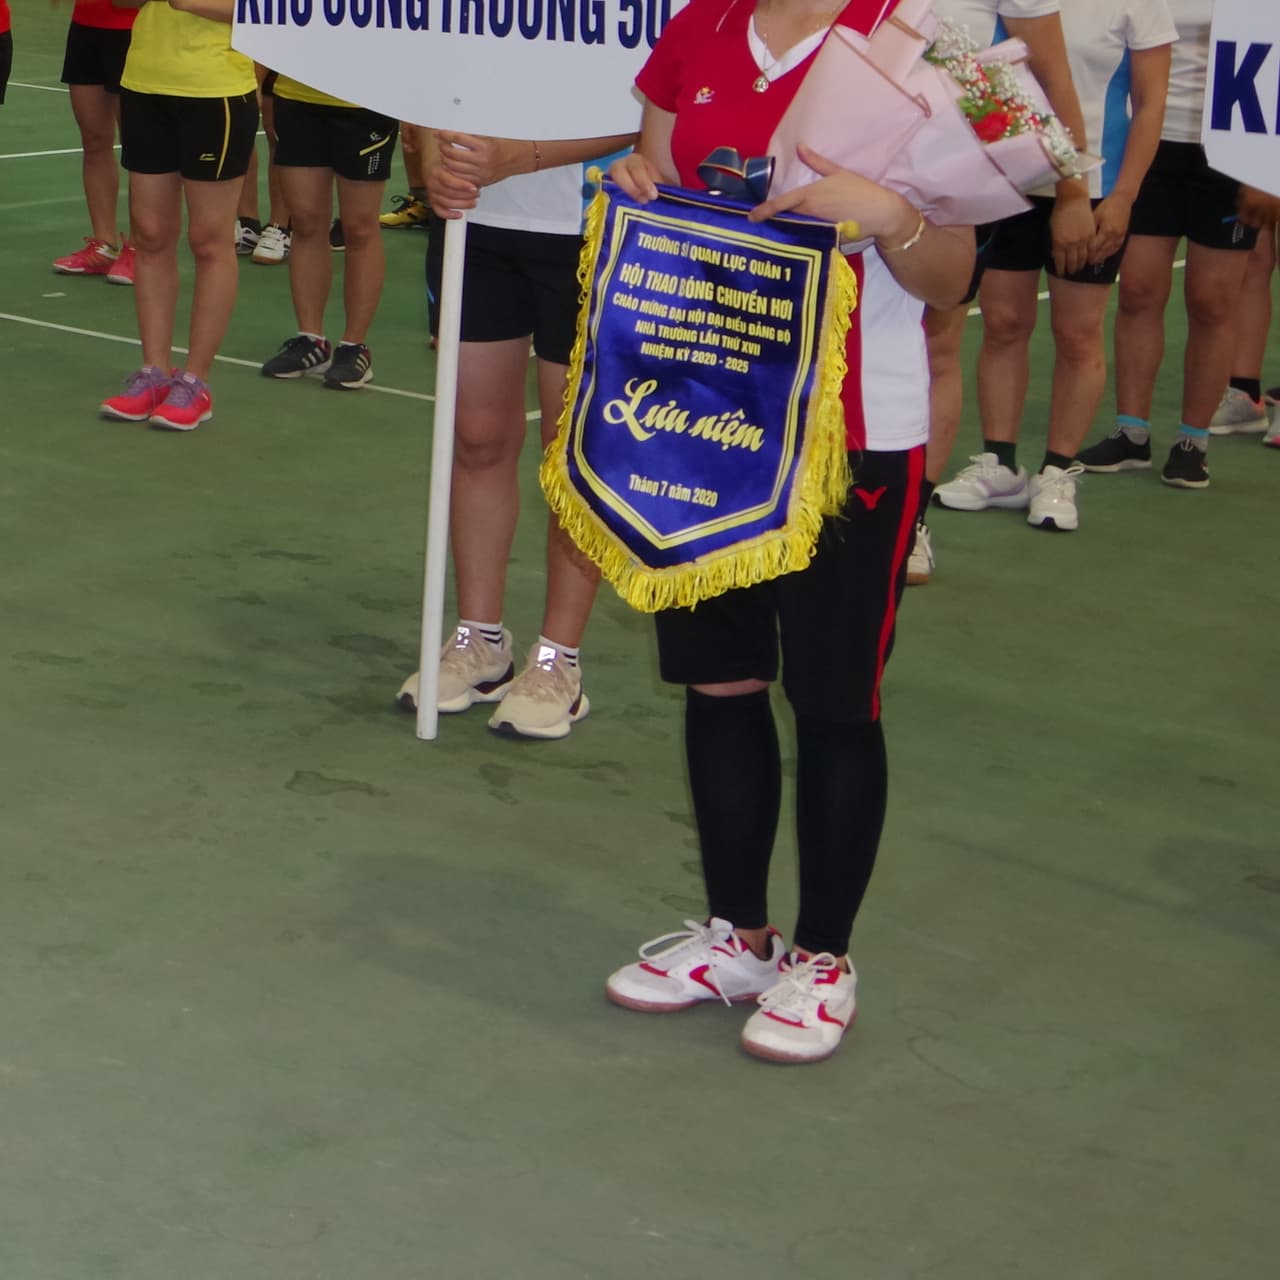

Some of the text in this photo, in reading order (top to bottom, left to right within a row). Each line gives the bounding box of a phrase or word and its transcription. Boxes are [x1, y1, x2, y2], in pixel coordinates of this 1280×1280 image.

[637, 232, 680, 255] TRƯỜNG
[690, 245, 721, 266] QUAN
[723, 253, 747, 273] LỤC
[749, 258, 782, 280] QUÂN
[785, 268, 791, 282] 1
[619, 263, 644, 290] HỘI
[645, 270, 678, 294] THAO
[679, 277, 715, 302] BÓNG
[770, 298, 794, 321] HƠI
[613, 292, 639, 311] CHÀO
[639, 299, 668, 319] MỪNG
[688, 308, 706, 327] HỘI
[707, 312, 725, 328] ĐẠI
[748, 321, 775, 340] ĐẢNG
[776, 327, 791, 346] BỘ
[635, 320, 657, 336] NHÀ
[658, 324, 697, 344] TRƯỜNG
[721, 335, 741, 352] THỨ
[741, 341, 761, 357] XVII
[641, 341, 674, 361] NHIỆM
[675, 346, 691, 362] KỲ
[691, 350, 718, 367] 2020
[725, 356, 749, 374] 2025
[603, 377, 765, 452] Lưu niệm
[629, 474, 719, 508] Tháng 7 năm 2020
